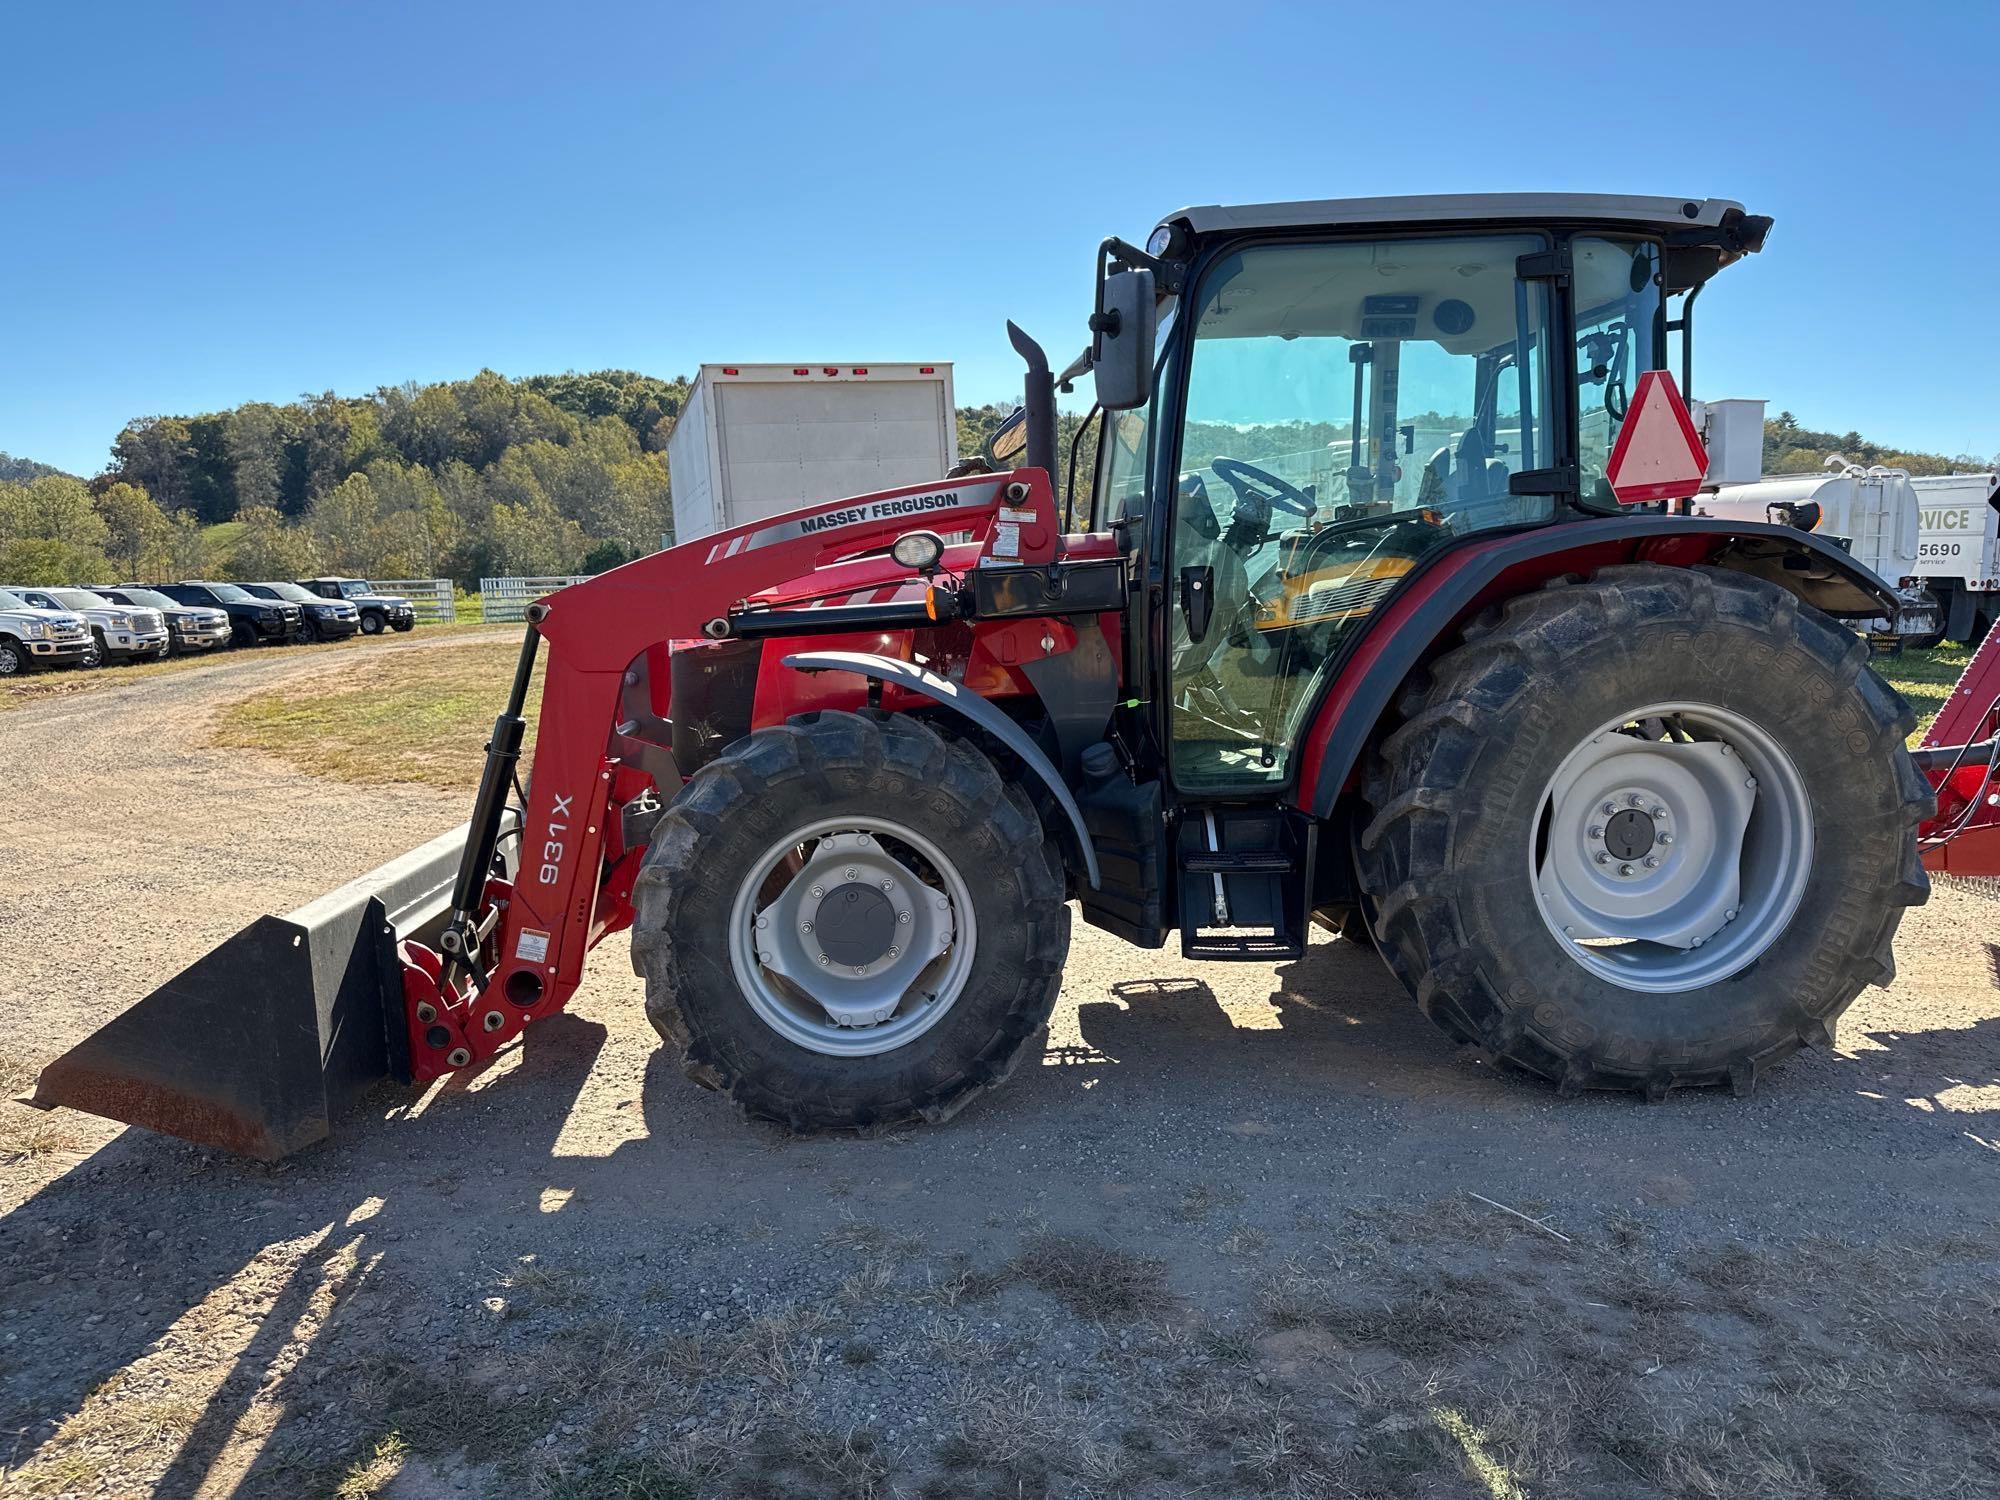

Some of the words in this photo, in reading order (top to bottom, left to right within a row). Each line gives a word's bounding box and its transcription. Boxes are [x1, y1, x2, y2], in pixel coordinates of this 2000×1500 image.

[800, 508, 867, 533] MASSEY
[872, 493, 958, 517] FERGUSON
[1919, 544, 1960, 556] 5690
